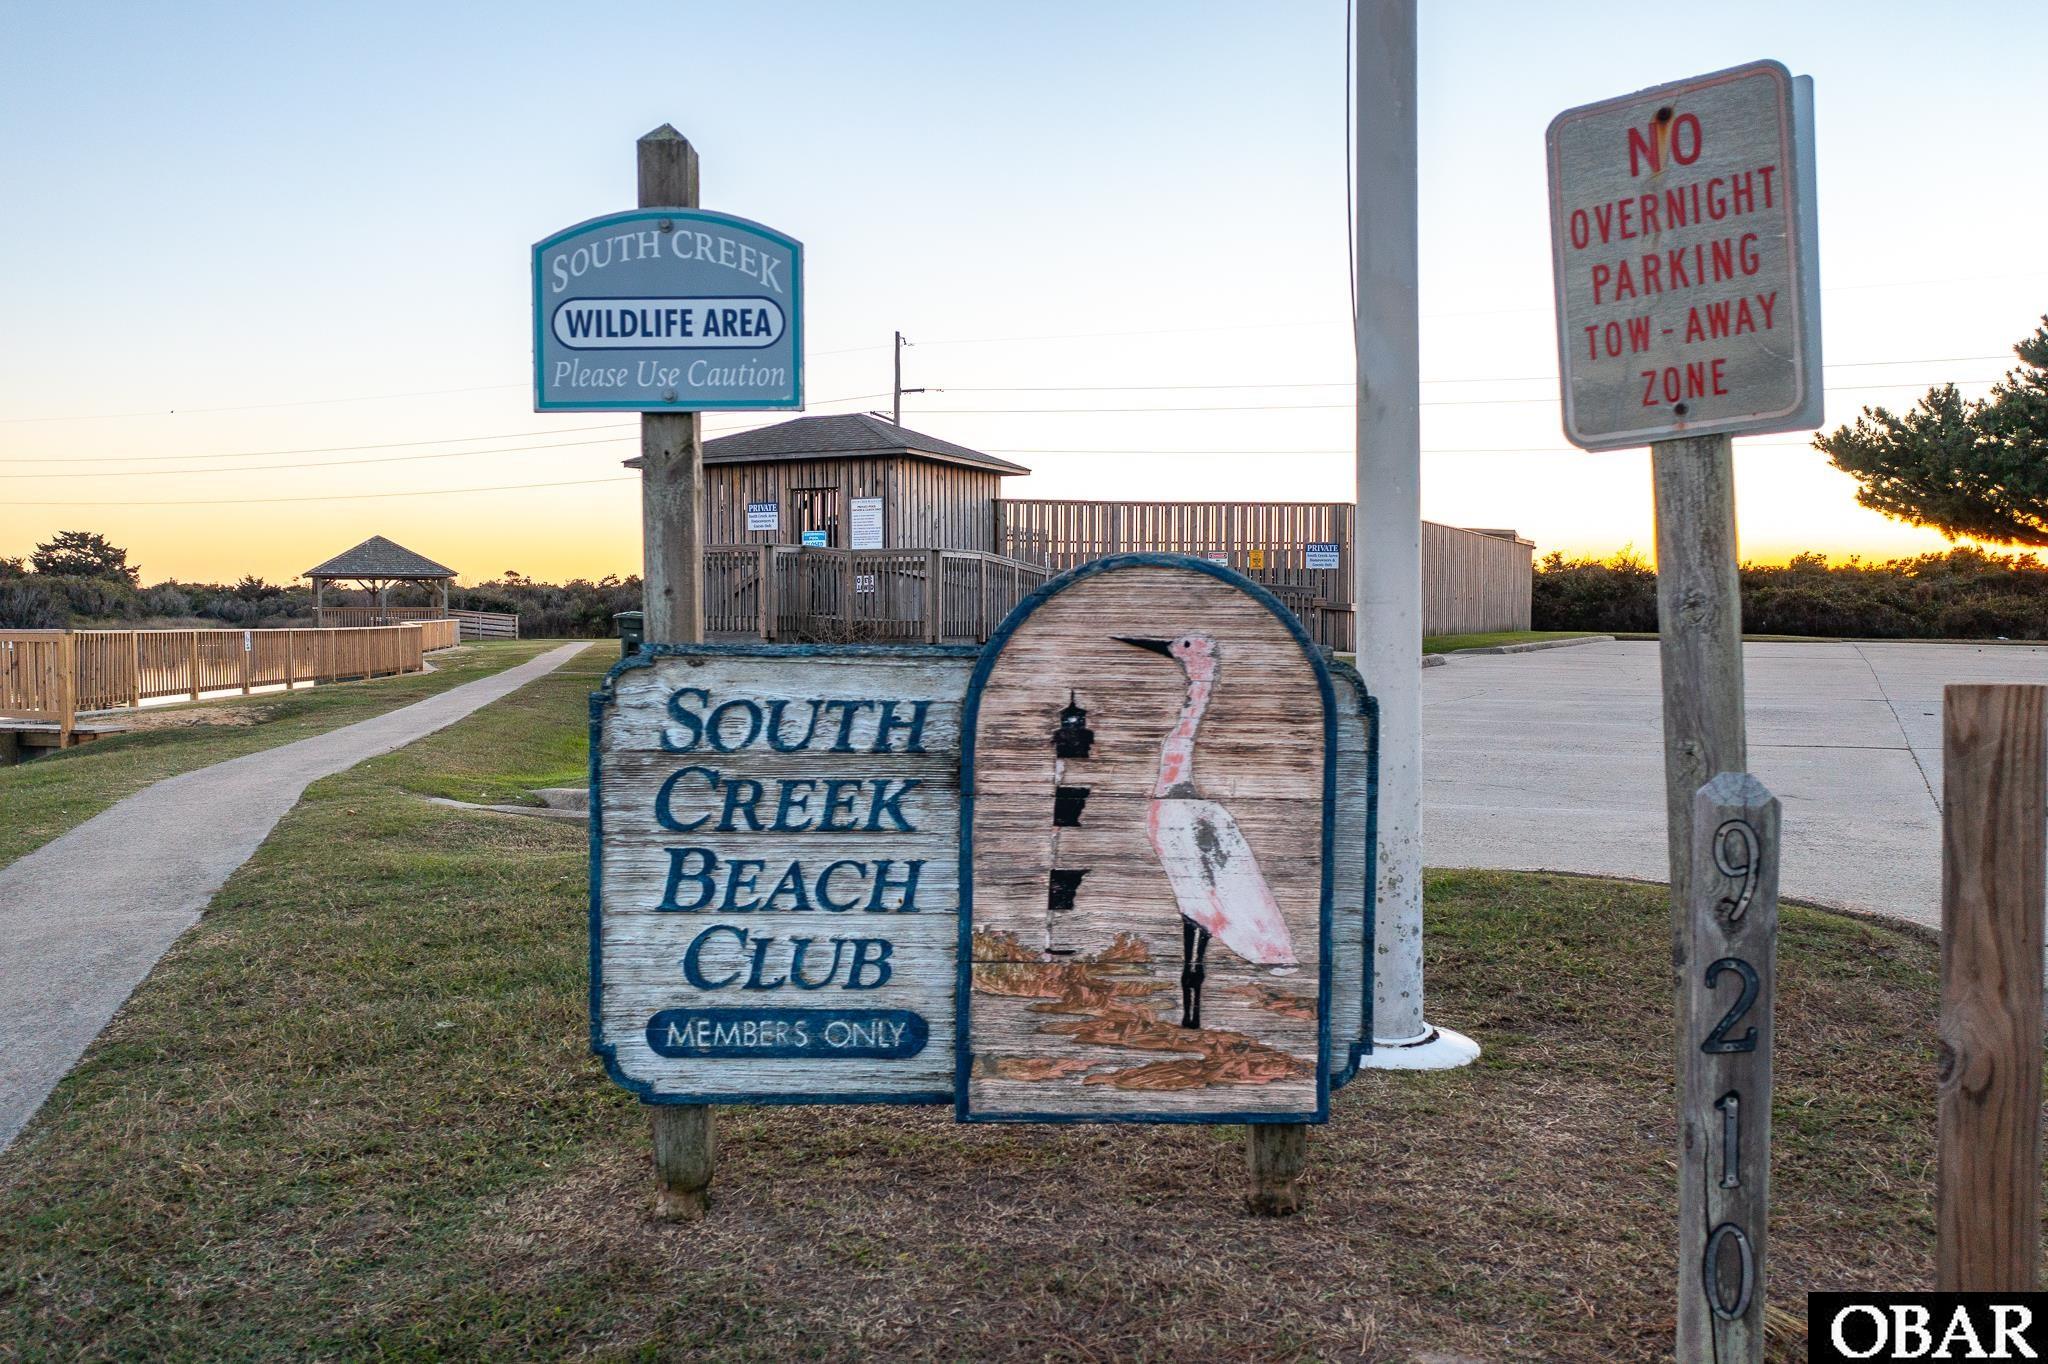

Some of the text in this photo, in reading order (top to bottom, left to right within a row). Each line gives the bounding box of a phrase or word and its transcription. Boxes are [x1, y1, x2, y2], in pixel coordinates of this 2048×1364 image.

[1627, 113, 1703, 177] NO
[1570, 165, 1776, 250] OVERNIGHT
[551, 230, 783, 294] SOUTH CREEK
[1591, 233, 1761, 306] PARKING
[565, 308, 773, 338] WILDLIFE AREA
[552, 358, 786, 388] Please Use Caution
[1640, 357, 1729, 408] ZONE
[748, 503, 778, 512] PRIVATE
[1307, 544, 1339, 552] PRIVATE
[660, 687, 933, 754] SOUTH
[655, 766, 922, 832] CREEK
[655, 847, 928, 913] BEACH
[682, 924, 894, 991] CLUB
[666, 1020, 906, 1048] MEMBERS ONLY
